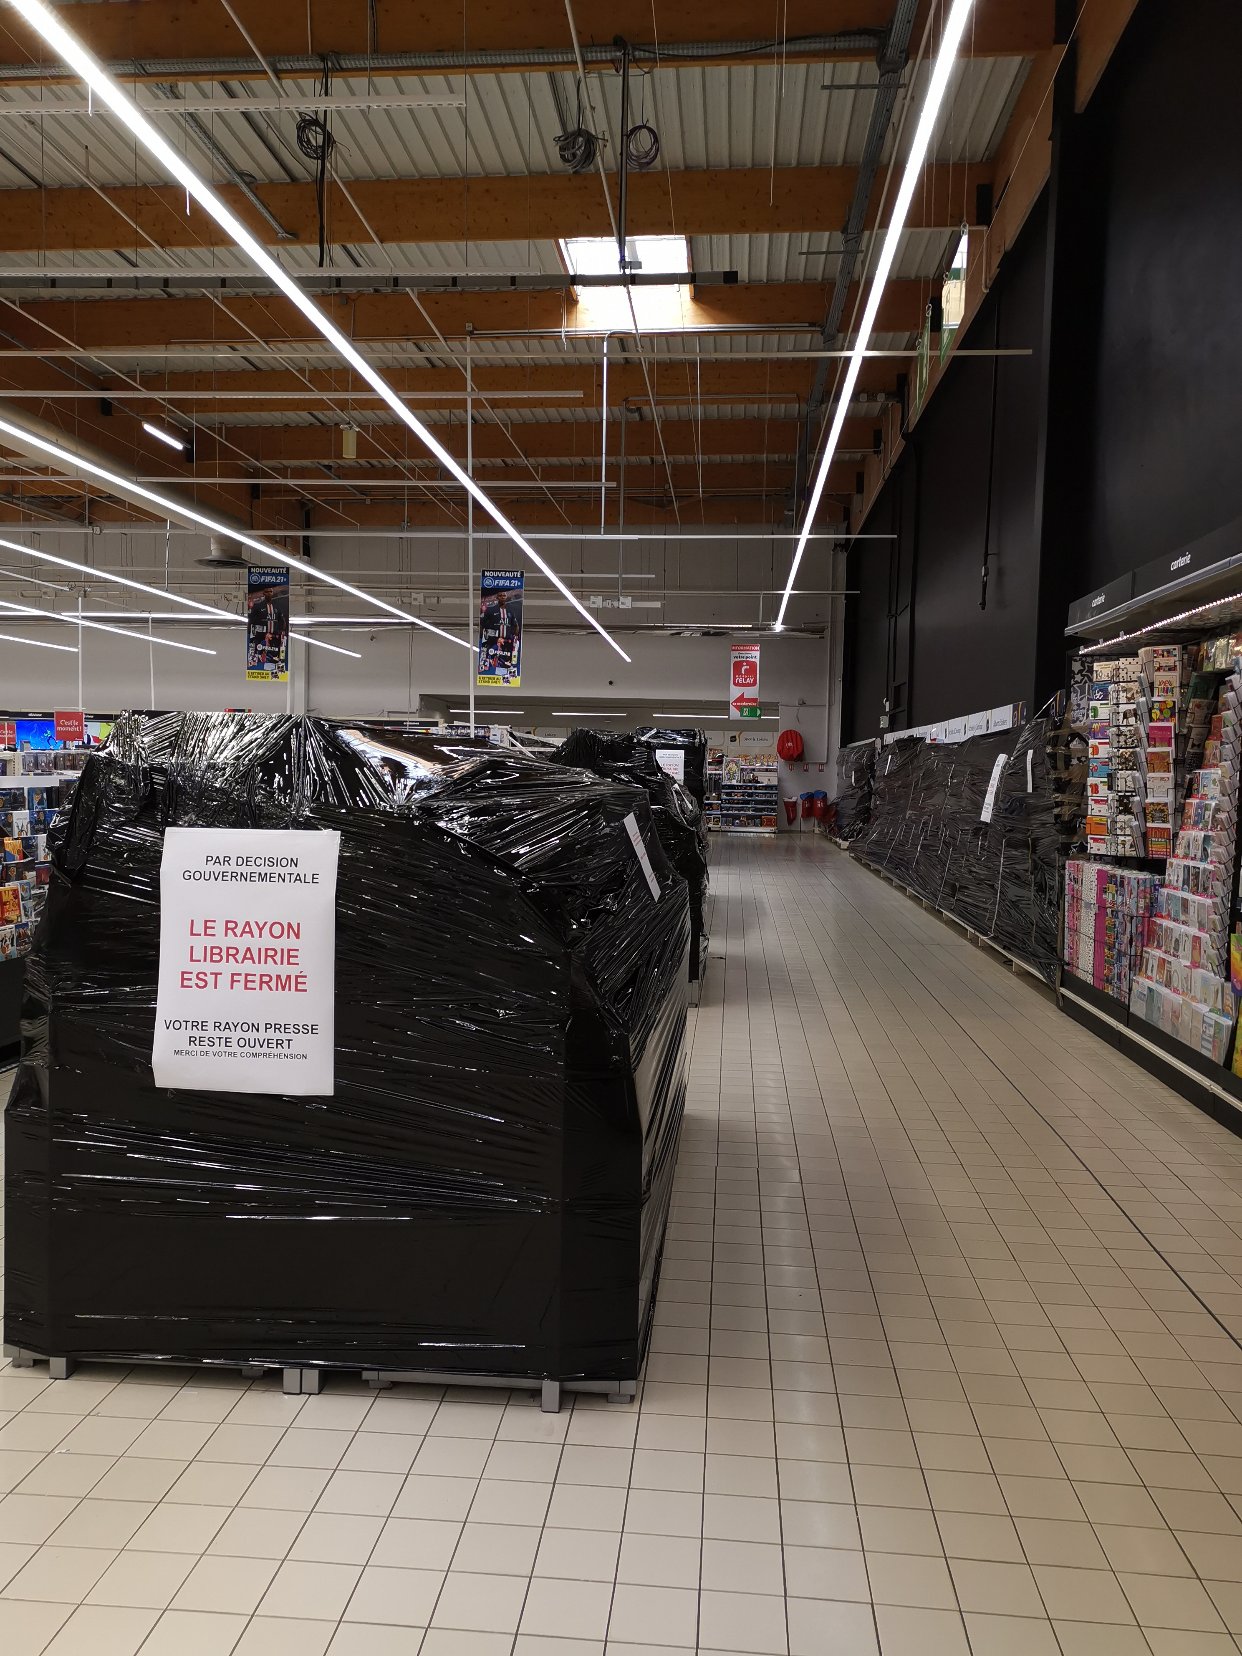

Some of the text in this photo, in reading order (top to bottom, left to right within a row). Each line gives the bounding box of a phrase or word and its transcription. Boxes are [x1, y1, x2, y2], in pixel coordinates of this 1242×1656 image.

[1170, 551, 1191, 571] carterie
[260, 575, 276, 583] FIFA
[484, 570, 521, 578] NOUVEAUTÉ
[494, 579, 510, 587] FIFA
[205, 855, 299, 868] PAR DECISION
[182, 869, 320, 884] GOUVERNEMENTALE
[189, 919, 301, 940] LE RAYON
[189, 945, 300, 966] LIBRAIRIE
[180, 970, 308, 993] EST FERMÉ
[164, 1019, 319, 1035] VOTRE RAYON PRESSE
[188, 1035, 294, 1050] RESTE OUVERT
[173, 1049, 198, 1057] MERCI
